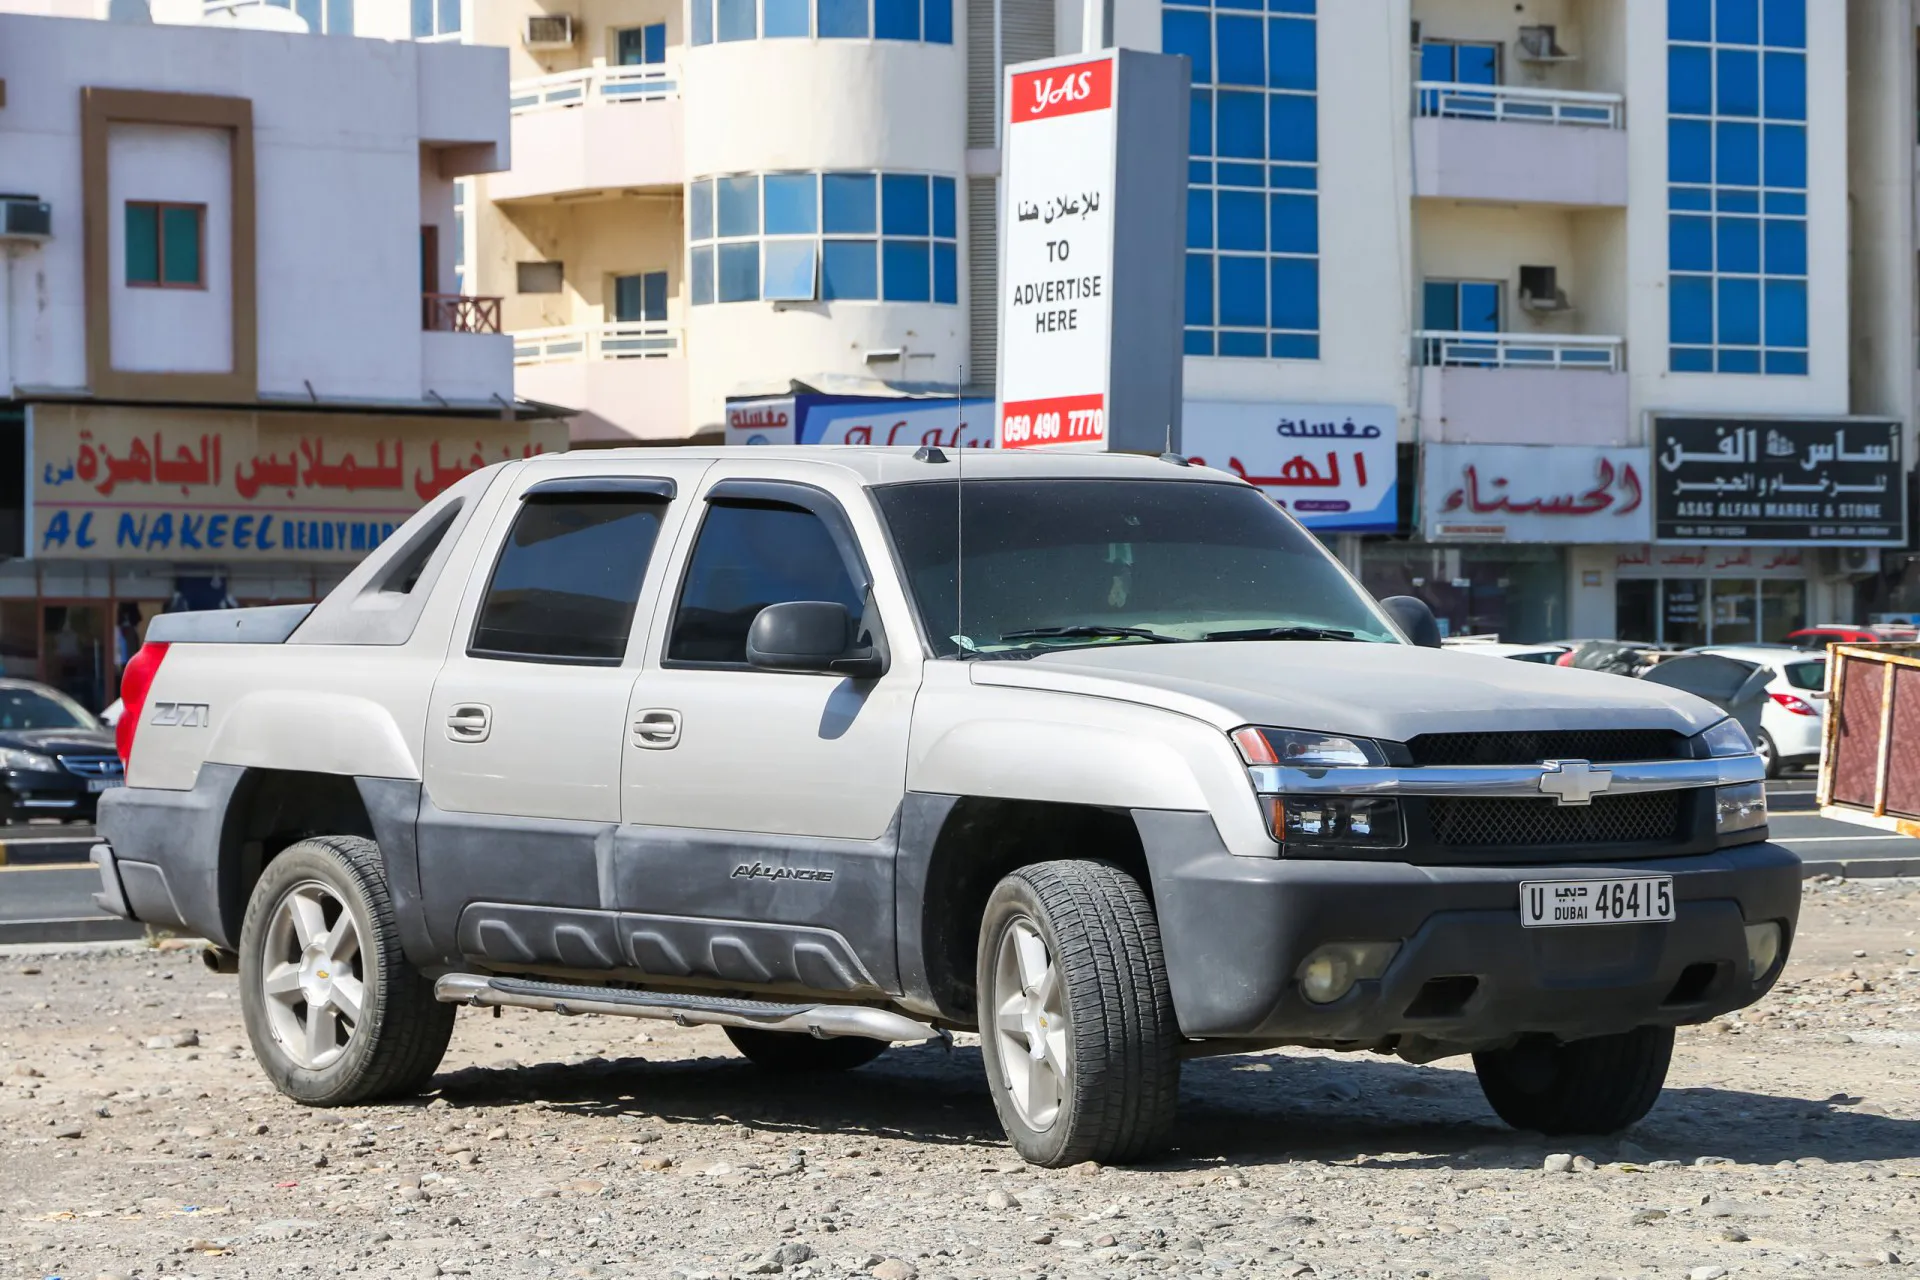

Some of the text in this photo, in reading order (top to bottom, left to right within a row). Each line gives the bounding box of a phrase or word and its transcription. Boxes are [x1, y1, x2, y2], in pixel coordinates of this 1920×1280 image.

[1030, 71, 1092, 113] YAS
[1018, 191, 1100, 224] للإعلان هنا
[1046, 239, 1070, 263] TO
[1013, 275, 1101, 306] ADVERTISE
[1036, 308, 1077, 333] HERE
[730, 405, 788, 429] مغسلة
[1005, 408, 1103, 441] 050 490 7770
[1276, 417, 1382, 439] مغسلة
[76, 429, 222, 497] الجاهزة
[1659, 425, 1899, 471] أساس الفن
[235, 437, 403, 499] للملابس
[1437, 456, 1643, 516] الحسناء
[1677, 502, 1882, 518] ASAS ALFAN MARBLE & STONE
[43, 510, 97, 550] AL
[116, 511, 275, 551] NAKEEL
[150, 701, 210, 728] Z71
[730, 860, 834, 882] AVALANCHE
[1531, 881, 1672, 920] U 46415
[1555, 886, 1588, 902] دبي
[1554, 906, 1588, 920] DUBAI
